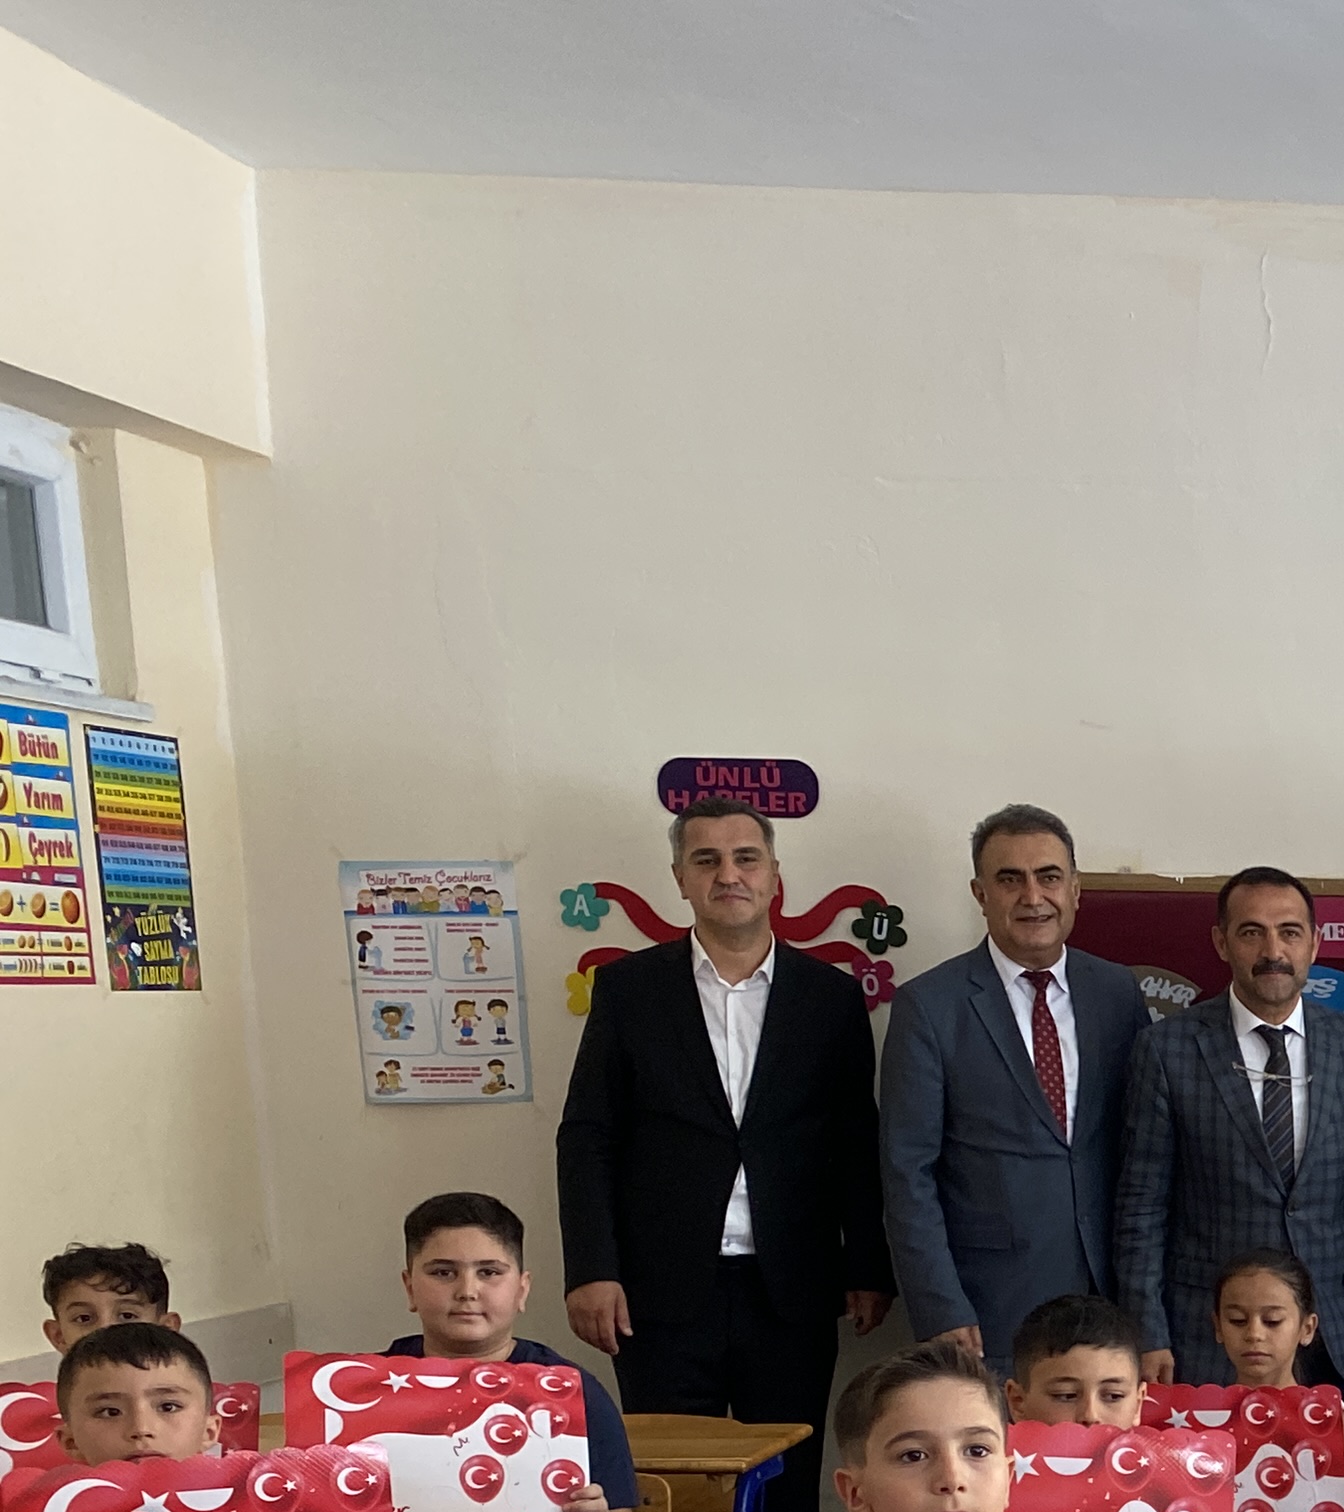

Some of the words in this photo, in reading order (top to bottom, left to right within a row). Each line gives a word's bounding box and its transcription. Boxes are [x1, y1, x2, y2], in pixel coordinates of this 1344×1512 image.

[17, 730, 60, 760] Bütün
[695, 761, 781, 788] ÜNLÜ
[22, 780, 64, 812] Yarım
[28, 830, 74, 865] Çeyrek
[365, 873, 397, 886] Bizler
[398, 872, 432, 885] Temiz
[573, 894, 591, 917] A
[873, 911, 888, 940] Ü
[137, 966, 179, 985] TABLOSU
[861, 968, 879, 996] Ö
